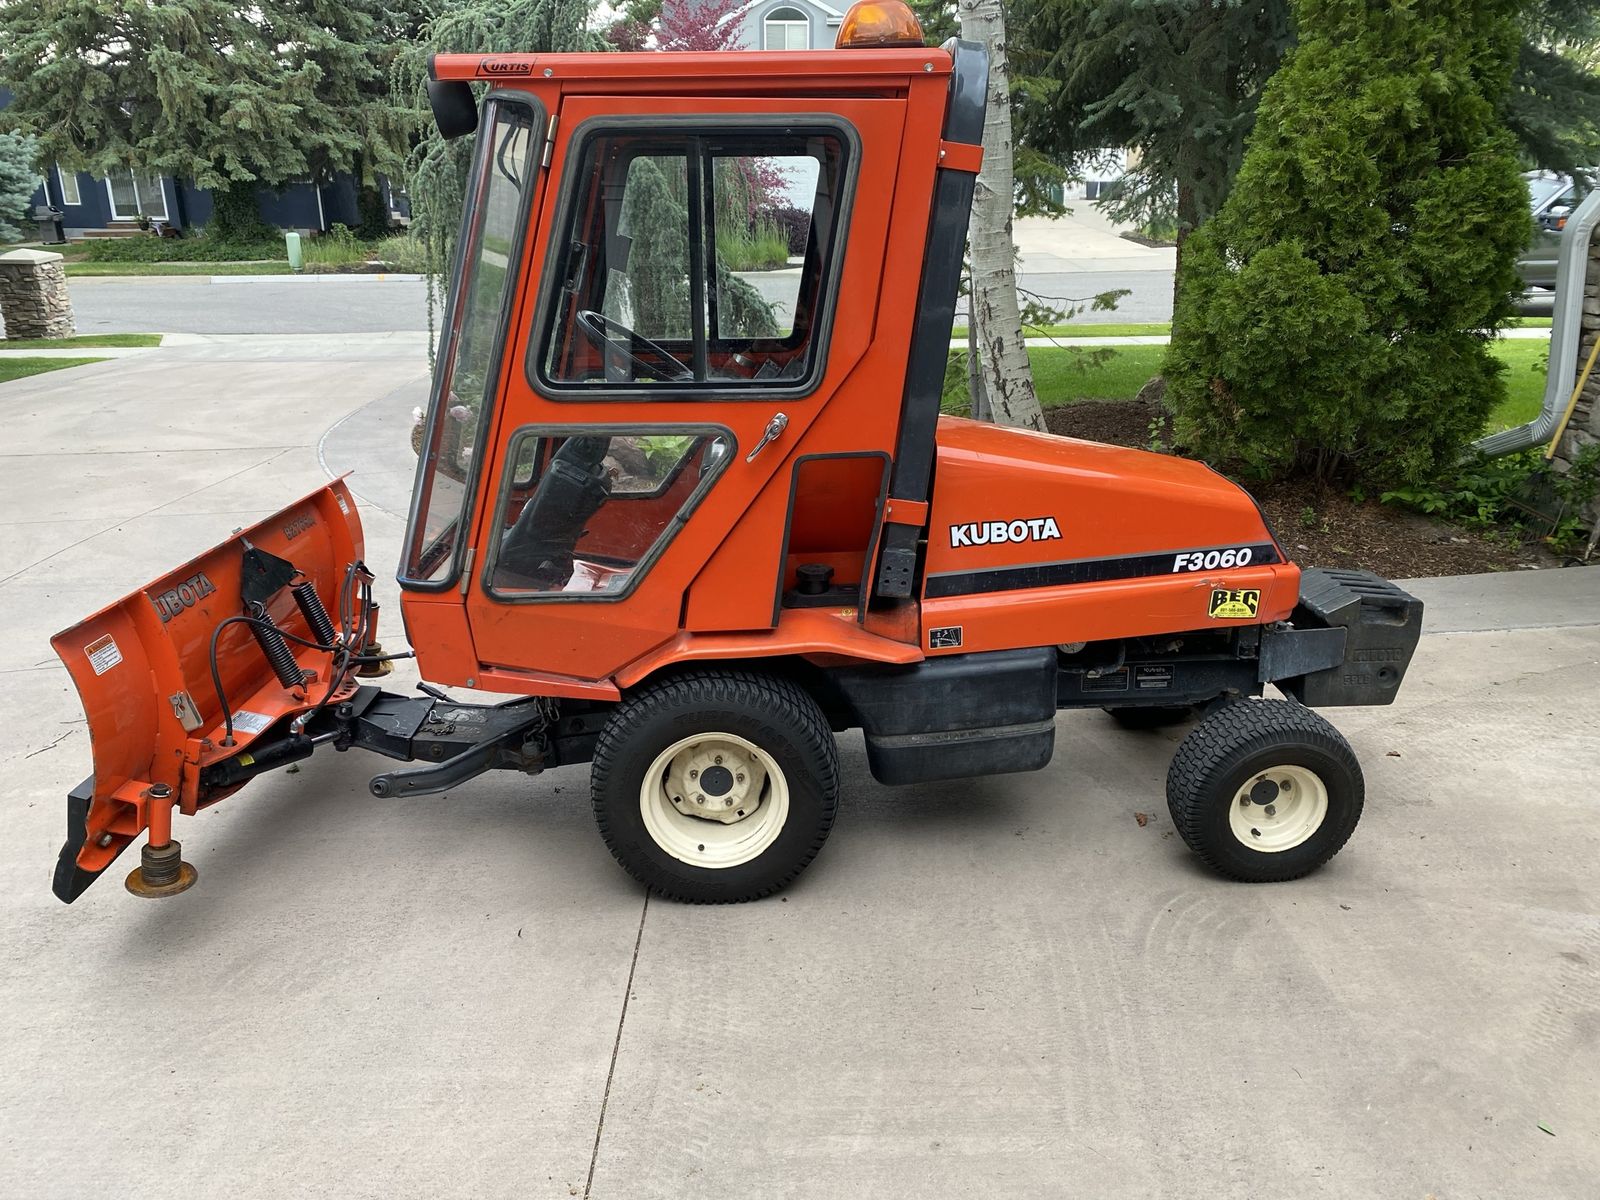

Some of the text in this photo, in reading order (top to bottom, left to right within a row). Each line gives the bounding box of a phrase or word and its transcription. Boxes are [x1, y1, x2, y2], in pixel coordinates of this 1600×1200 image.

[482, 57, 530, 73] CURTIS
[950, 517, 1061, 547] KUBOTA
[1172, 548, 1252, 573] F3060
[153, 571, 216, 623] UBOTA
[1210, 590, 1258, 614] BEC
